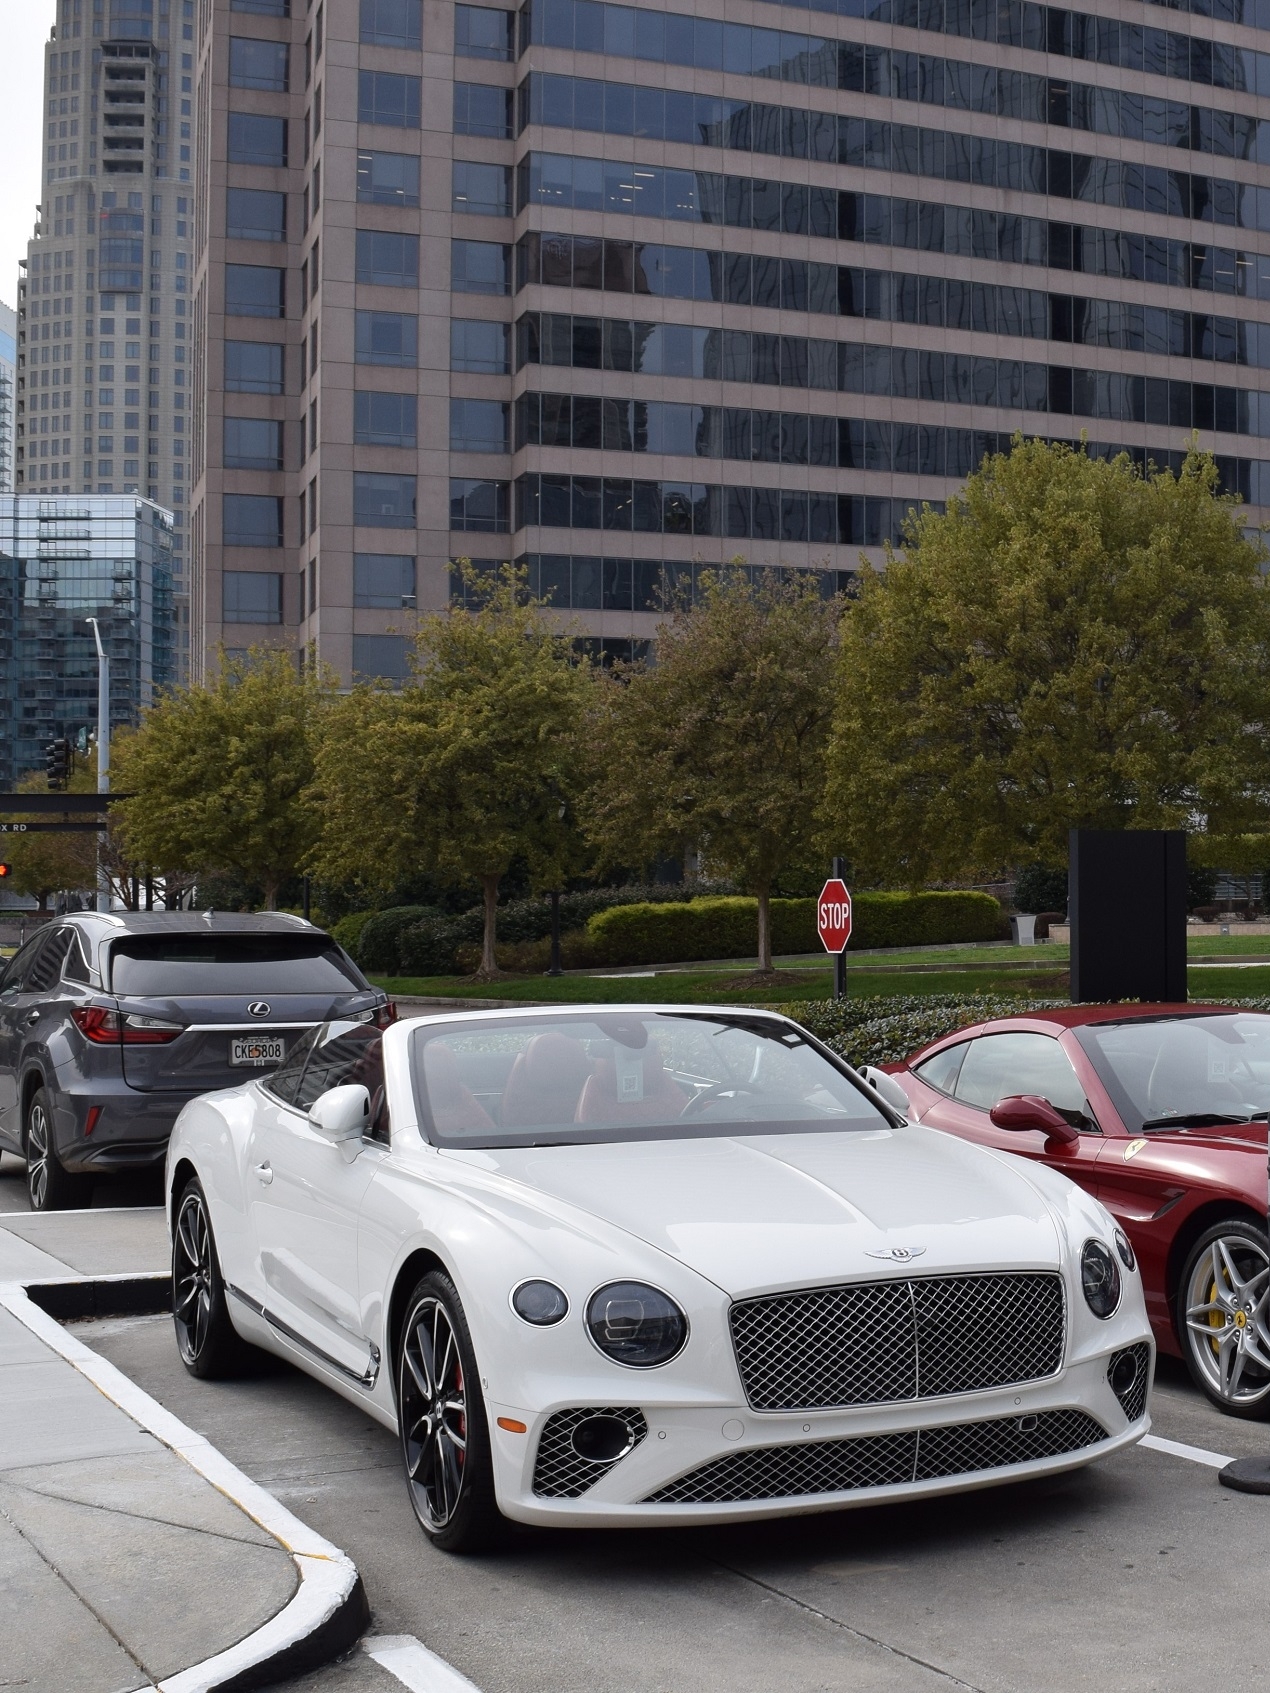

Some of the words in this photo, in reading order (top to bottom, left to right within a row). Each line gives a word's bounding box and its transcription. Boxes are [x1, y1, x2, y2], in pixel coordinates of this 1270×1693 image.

[0, 824, 8, 832] X
[13, 824, 27, 832] RD
[820, 902, 850, 930] STOP
[234, 1043, 282, 1059] CKE5808
